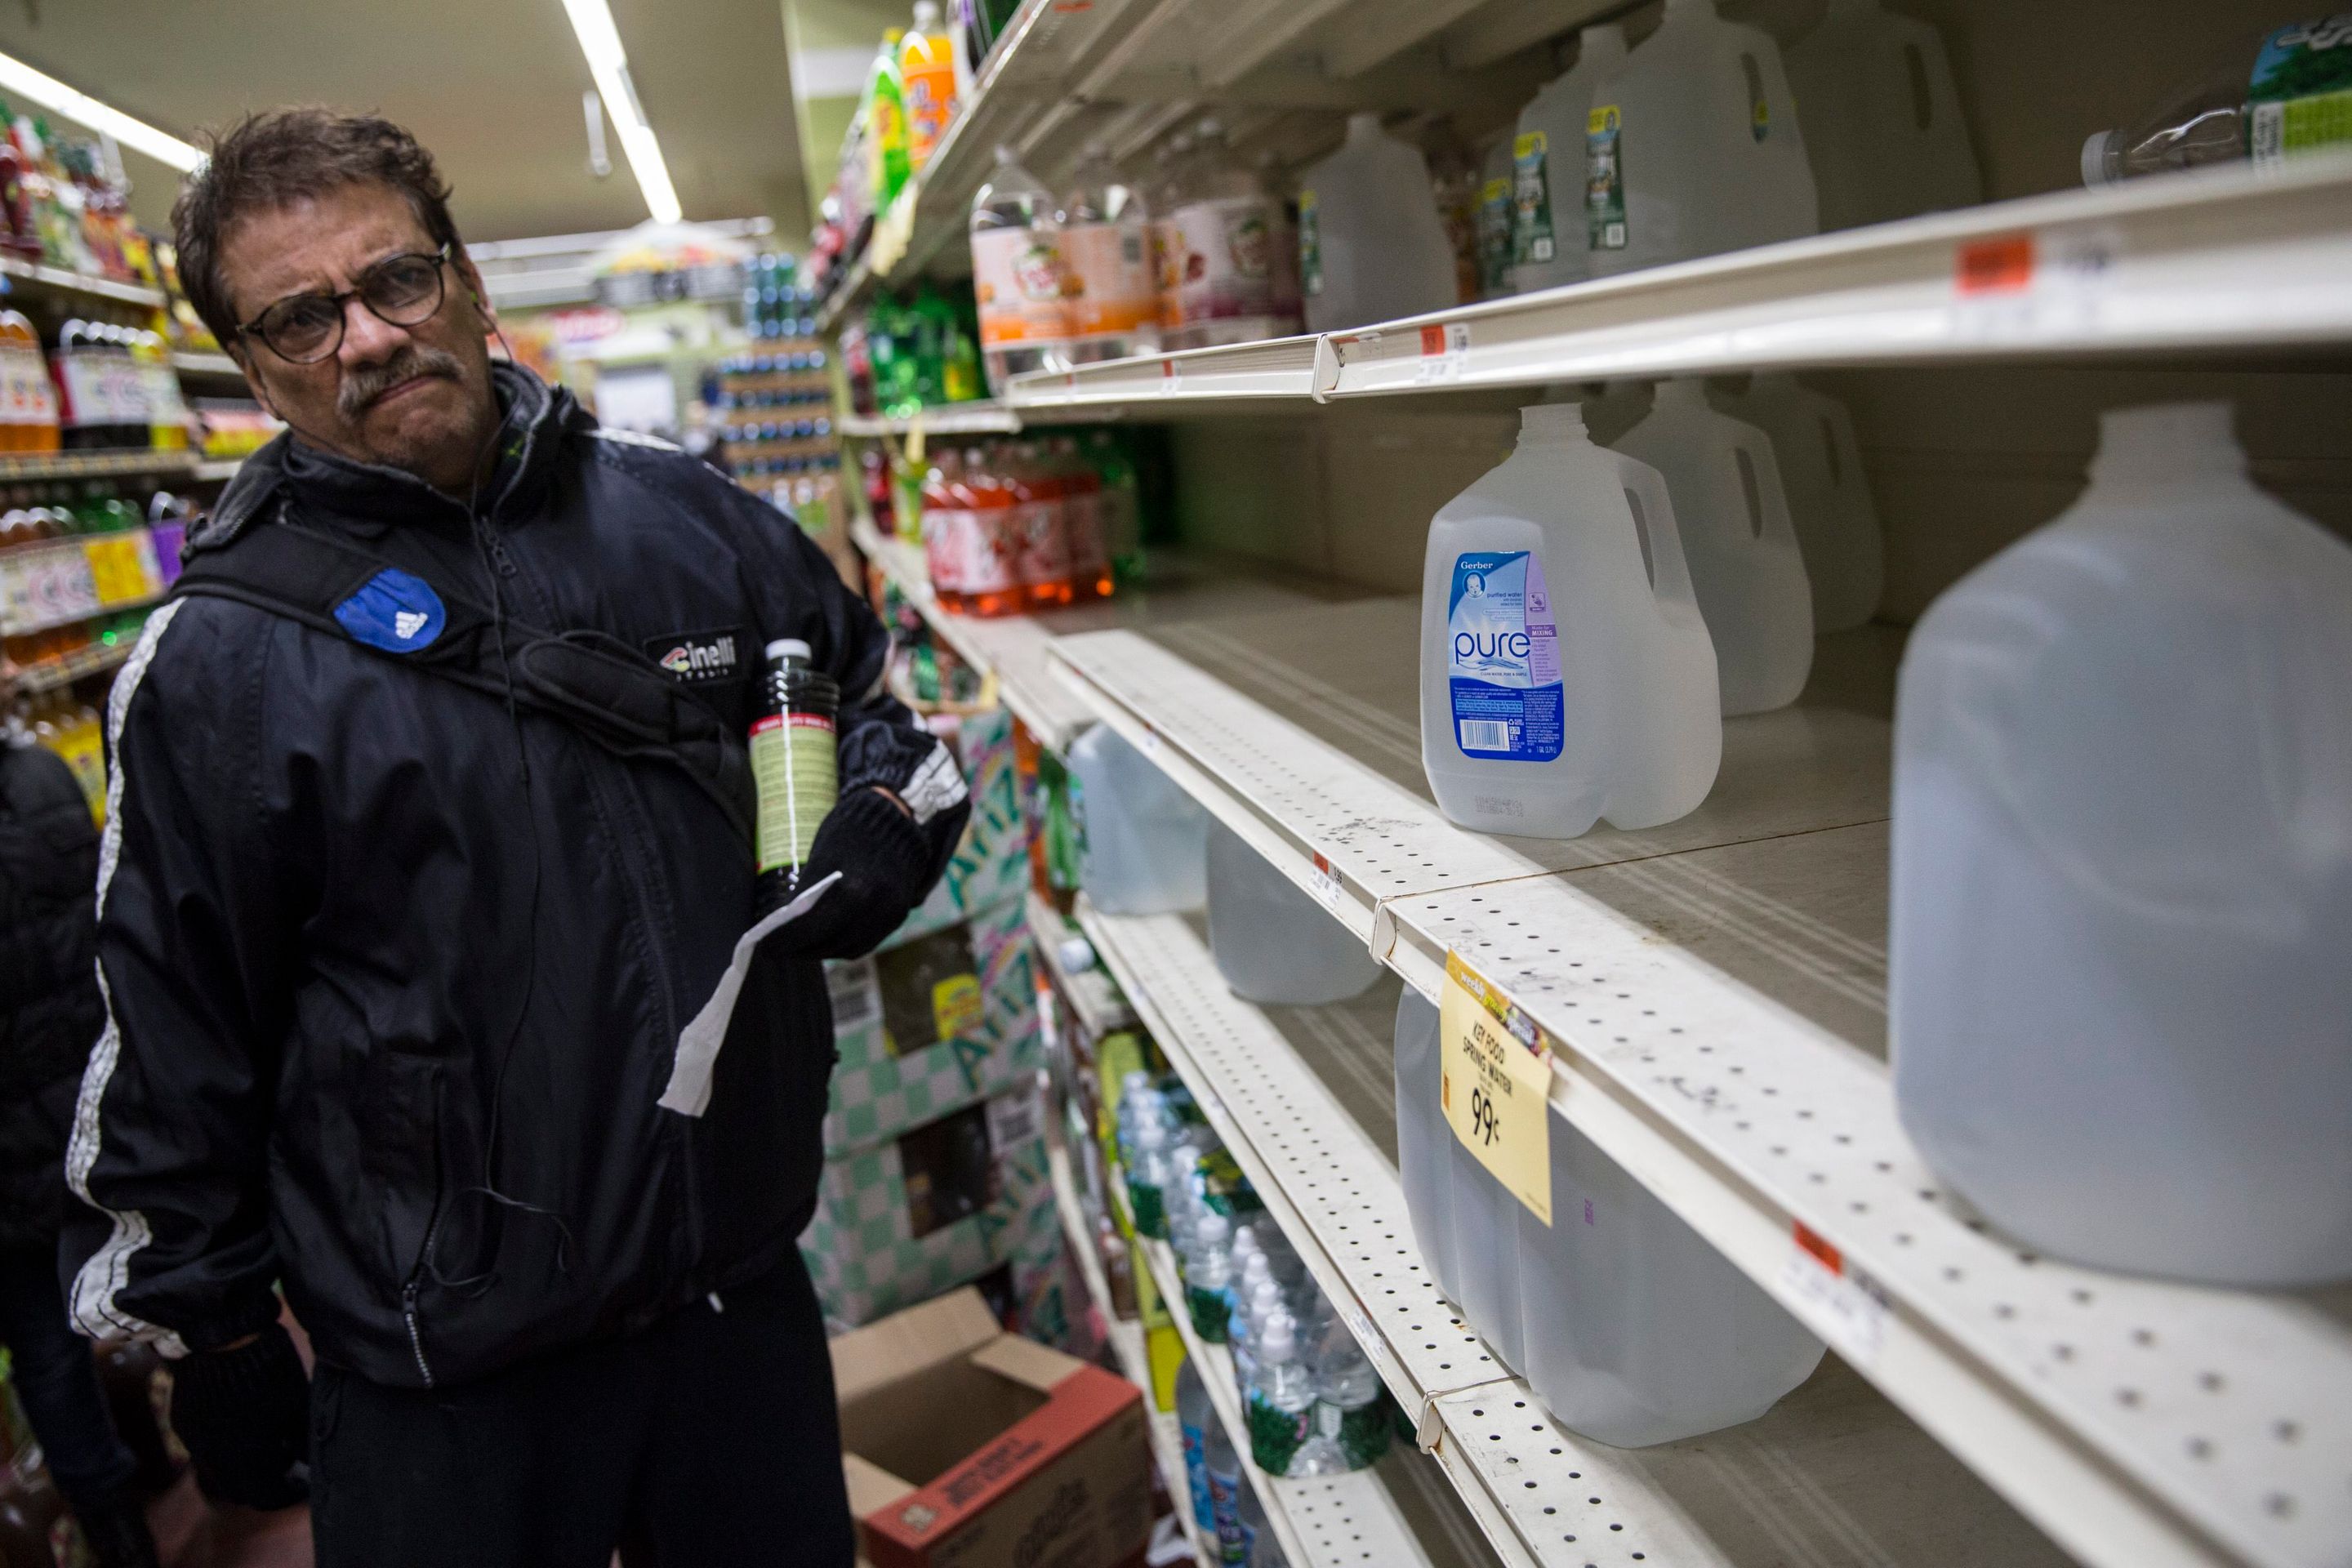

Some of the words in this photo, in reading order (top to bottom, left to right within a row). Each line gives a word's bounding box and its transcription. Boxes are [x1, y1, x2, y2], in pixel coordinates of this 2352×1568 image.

[1460, 561, 1494, 569] Gerber
[1454, 632, 1531, 665] pure
[1472, 1021, 1486, 1041] KEY
[1485, 1033, 1505, 1065] FOOD
[1463, 1036, 1486, 1072] SPRING
[1488, 1062, 1513, 1098] WATER
